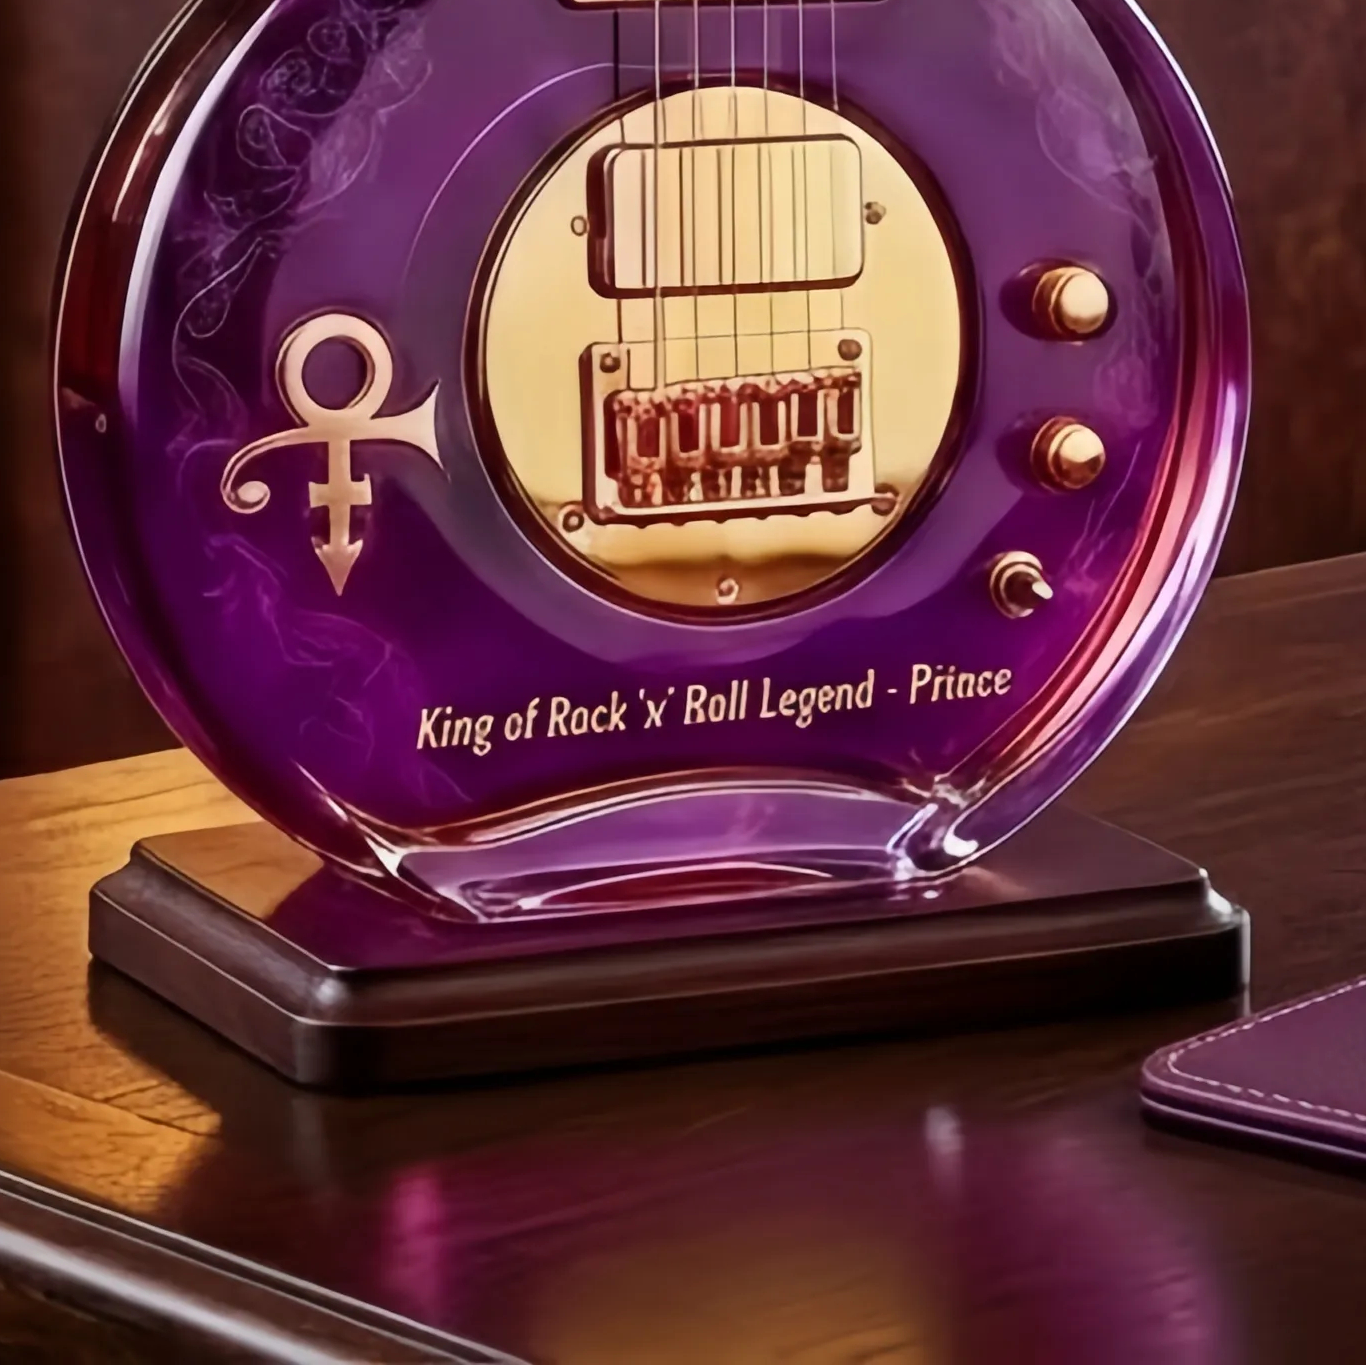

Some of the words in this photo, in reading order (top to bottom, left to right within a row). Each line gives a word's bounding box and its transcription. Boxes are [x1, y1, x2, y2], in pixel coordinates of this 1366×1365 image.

[416, 706, 494, 756] King
[504, 697, 540, 741] of
[759, 669, 875, 728] Legend
